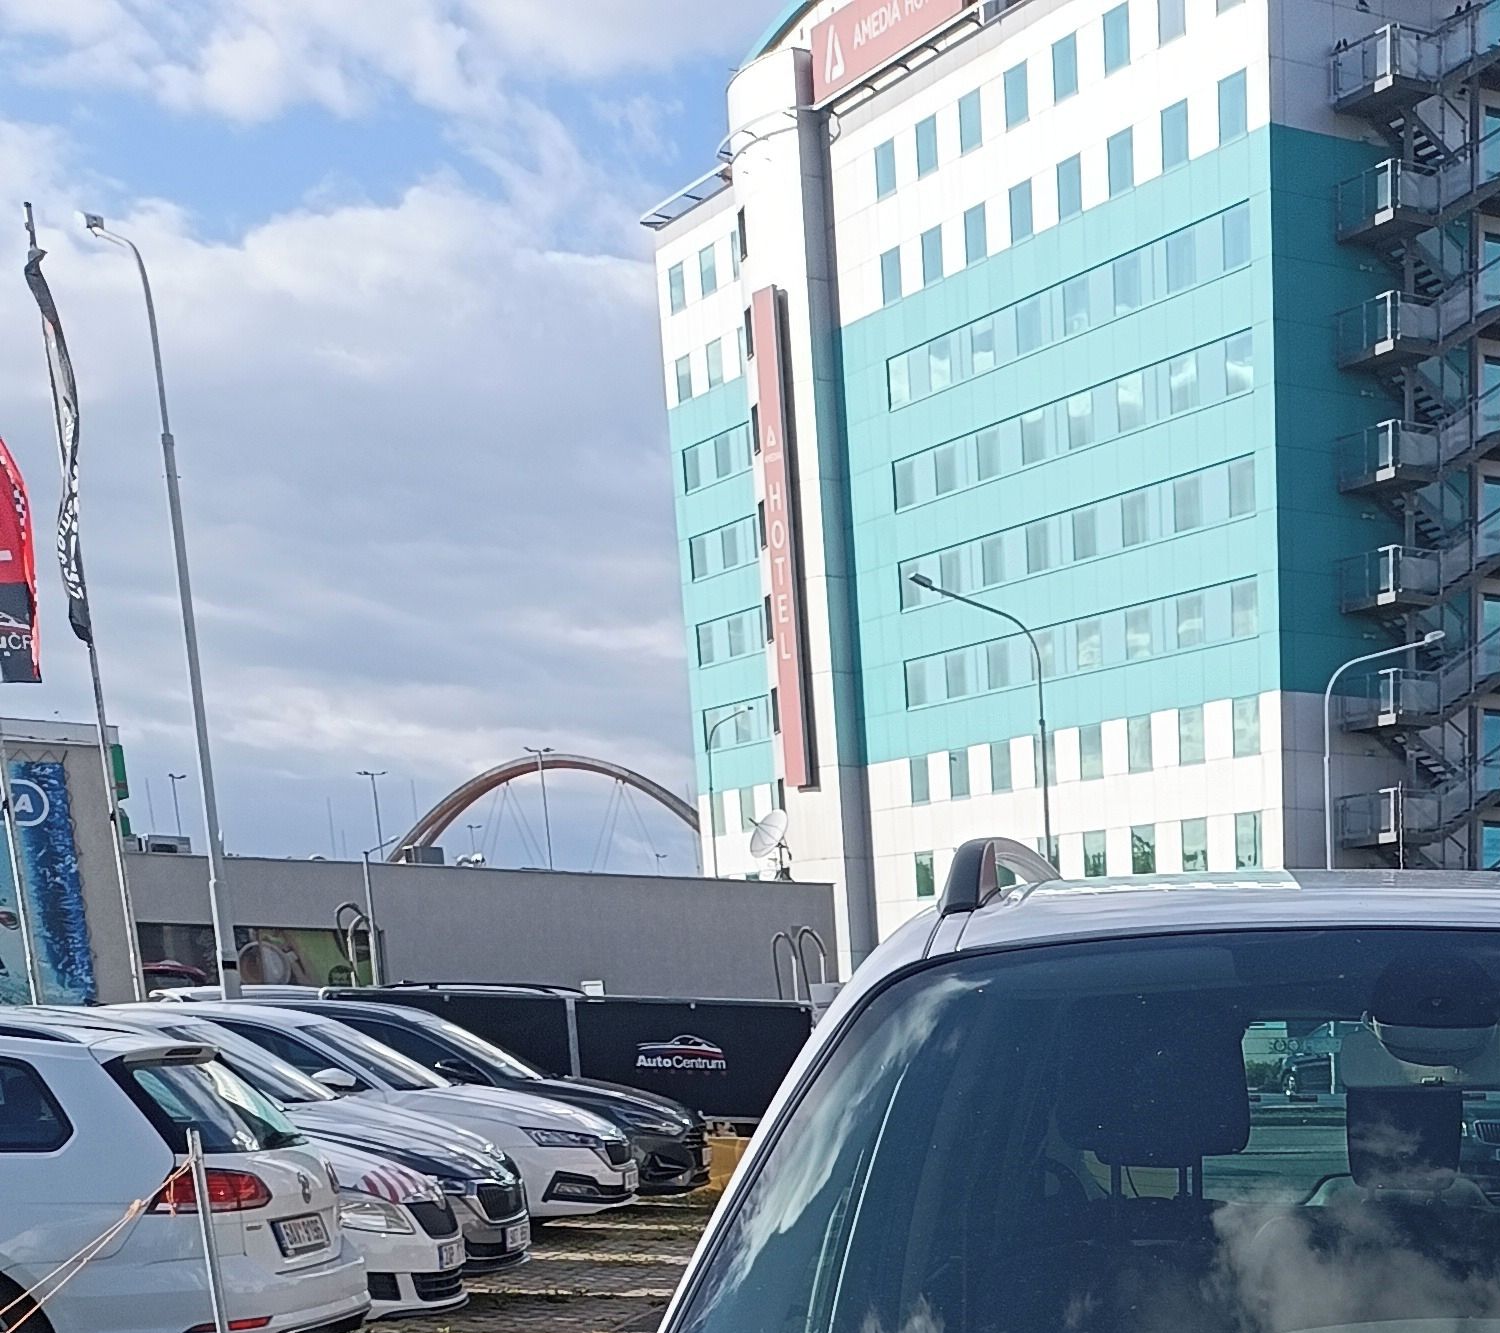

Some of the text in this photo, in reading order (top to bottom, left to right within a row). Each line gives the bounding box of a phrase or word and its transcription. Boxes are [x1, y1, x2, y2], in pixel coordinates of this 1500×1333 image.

[854, 0, 901, 48] AMEDIA
[768, 481, 792, 661] HOTEL
[636, 1055, 726, 1069] AutoCentrum
